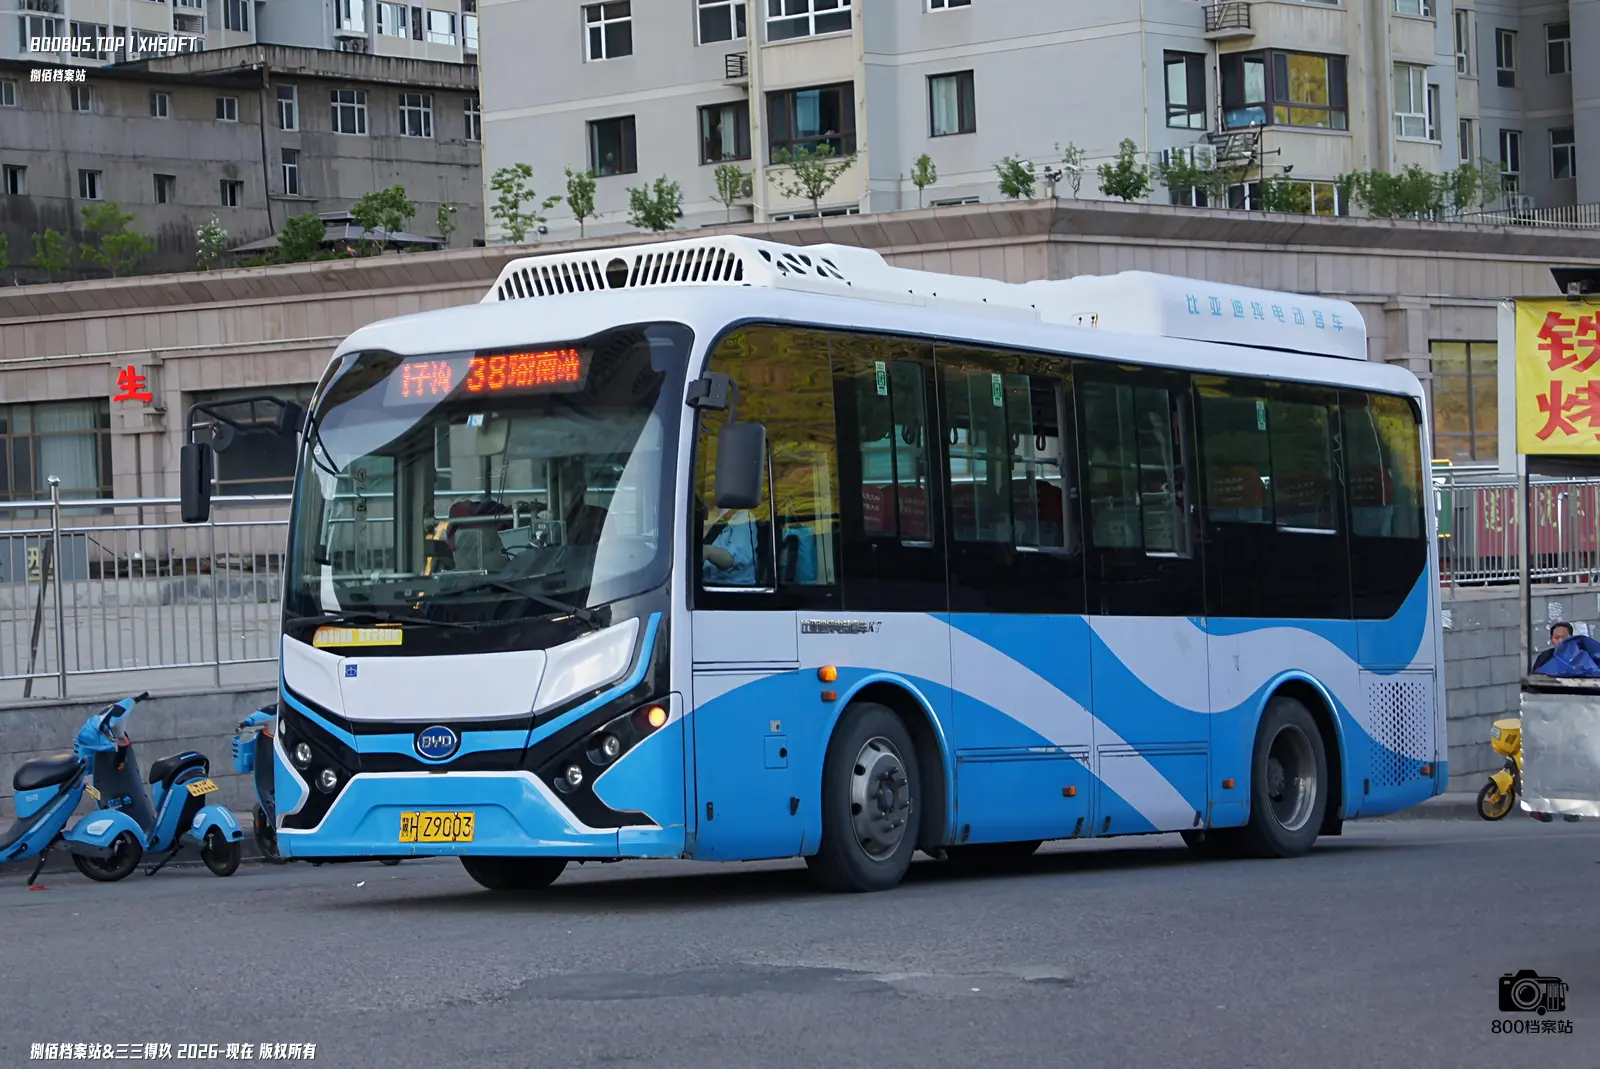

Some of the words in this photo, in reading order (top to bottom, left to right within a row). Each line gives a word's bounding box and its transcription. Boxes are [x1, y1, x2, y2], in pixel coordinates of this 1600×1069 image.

[1186, 293, 1343, 332] 比亚迪纯电动客车
[113, 364, 153, 403] 生
[422, 735, 452, 749] BYD
